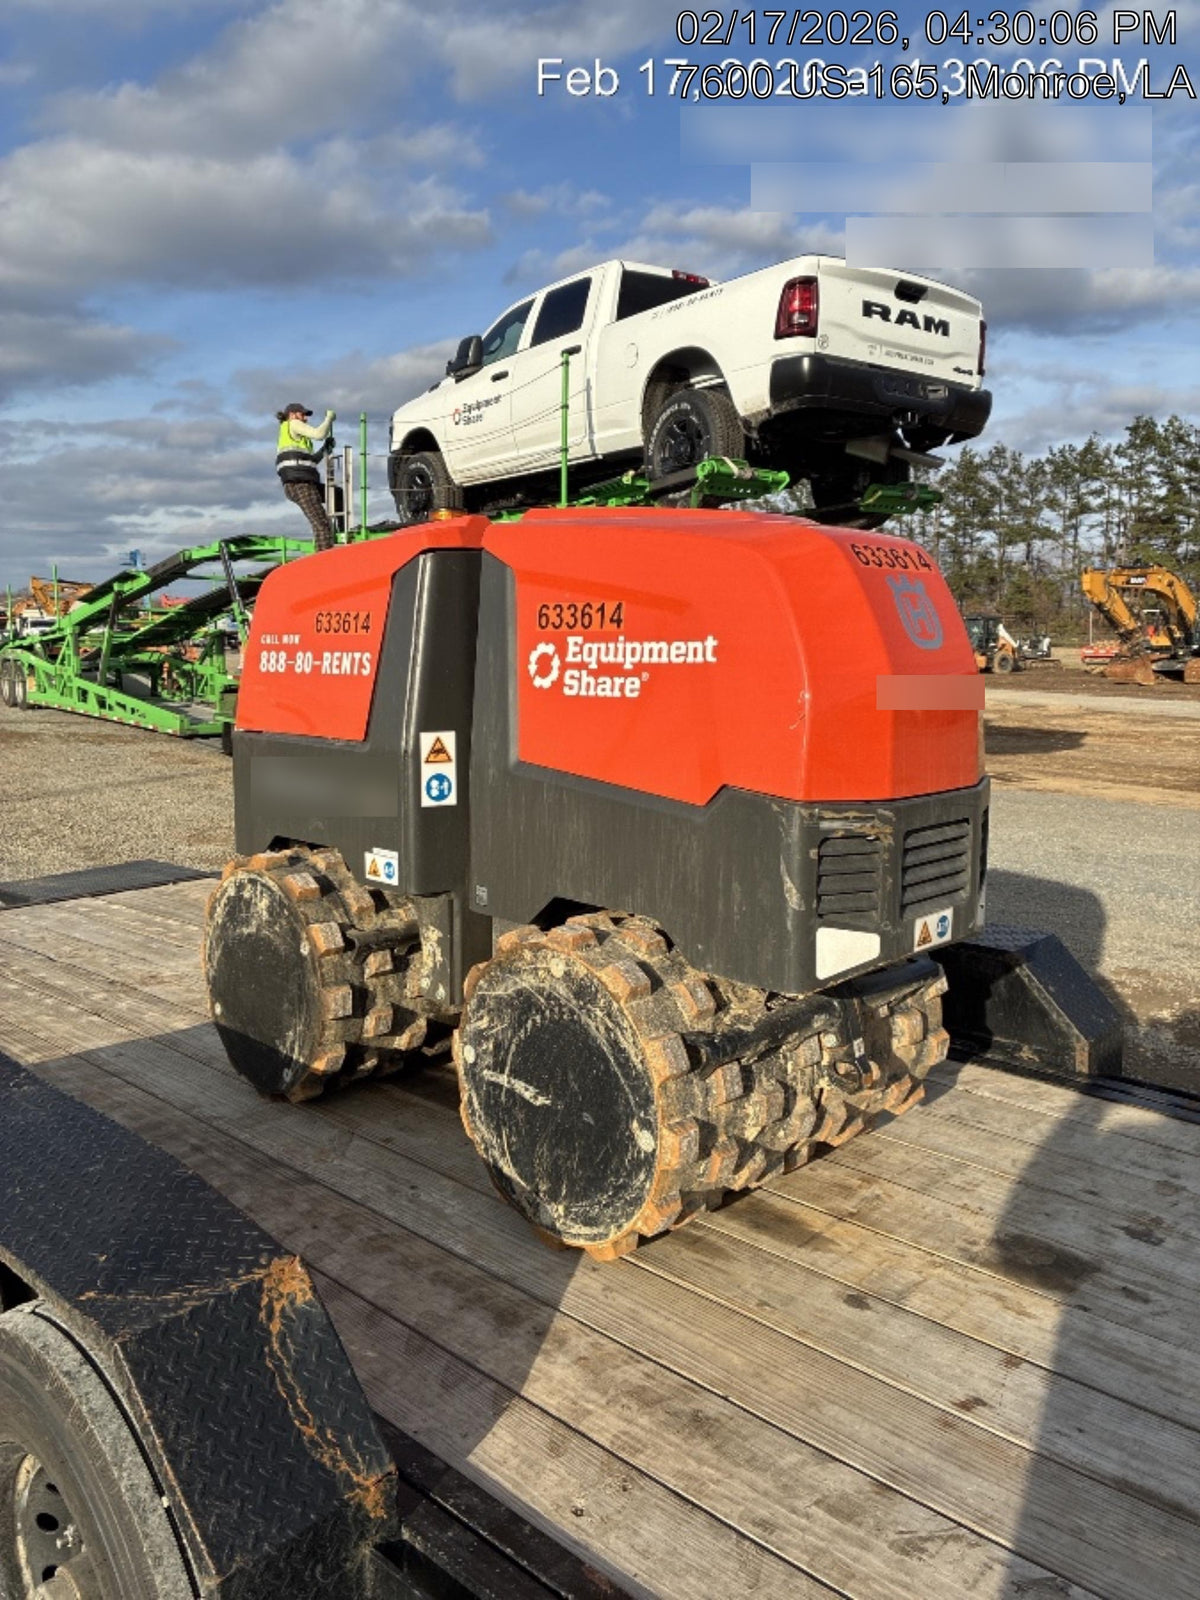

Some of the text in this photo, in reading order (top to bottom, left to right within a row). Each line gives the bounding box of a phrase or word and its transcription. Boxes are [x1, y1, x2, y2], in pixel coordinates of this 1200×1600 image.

[862, 300, 950, 337] RAM
[849, 543, 933, 572] 633614
[315, 612, 372, 634] 633614
[537, 602, 624, 630] 633614
[258, 650, 371, 676] 888-80-RENTS
[565, 635, 719, 669] Equipment
